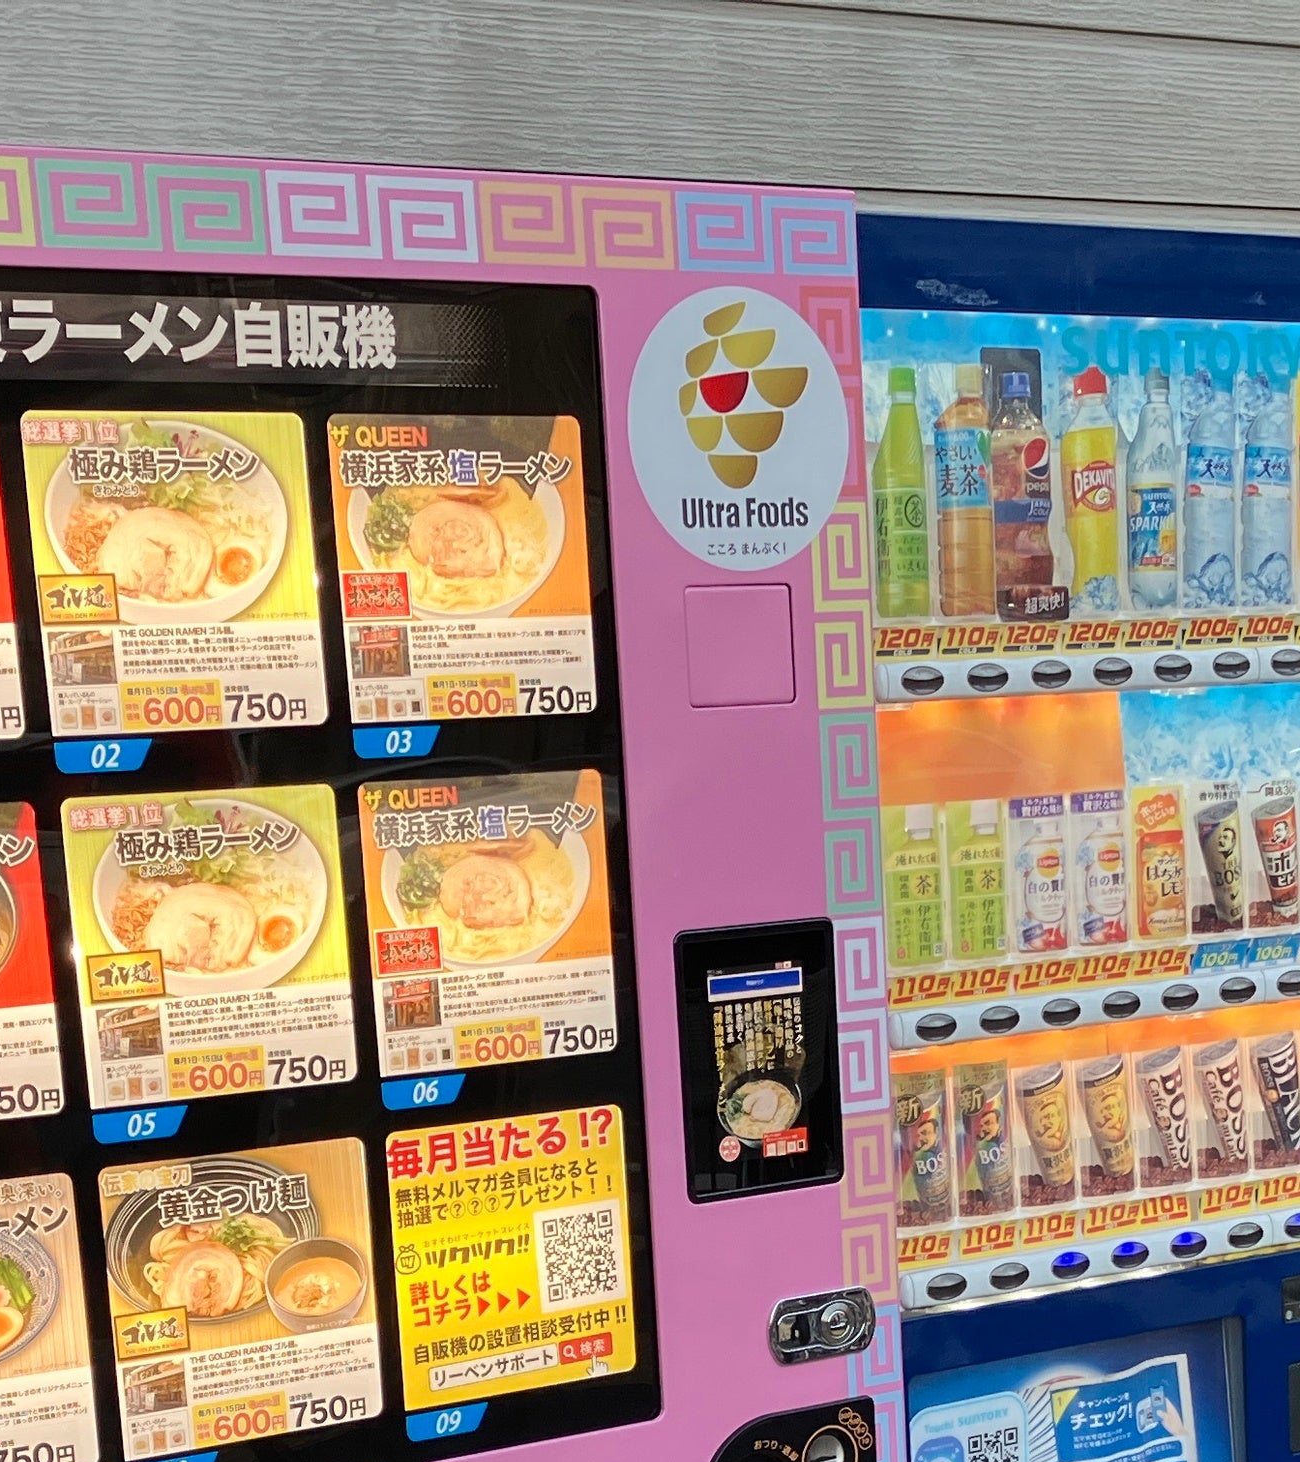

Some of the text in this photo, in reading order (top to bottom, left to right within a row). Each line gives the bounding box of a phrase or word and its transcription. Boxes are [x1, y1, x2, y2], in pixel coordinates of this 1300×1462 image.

[331, 425, 427, 448] ザ QUEEN
[69, 449, 258, 483] 極み鶏ラーメン
[936, 447, 976, 462] やさしい
[340, 451, 571, 484] 横浜家系塩ラーメン
[93, 484, 139, 497] きわみどり
[939, 464, 978, 497] 麦茶
[682, 498, 809, 528] Ultra Foods
[905, 496, 924, 525] 茶
[707, 543, 786, 555] こころ まんぷく!
[948, 628, 999, 646] 110円
[1004, 626, 1058, 644] 120円
[1066, 622, 1120, 642] 120円
[1129, 621, 1178, 640] 100円
[1189, 617, 1238, 637] 100円
[1246, 615, 1293, 635] 100円
[879, 628, 936, 648] 120円
[144, 697, 220, 724] 600円
[224, 694, 306, 723] 750円
[447, 690, 514, 715] 600円
[519, 687, 592, 714] 750円
[386, 730, 413, 754] 03
[91, 744, 121, 769] 02
[364, 786, 458, 811] ザ QUEEN
[373, 801, 597, 847] 横浜家系塩ラーメン
[116, 822, 300, 864] 極み鶏ラーメン
[916, 874, 932, 896] 茶
[980, 869, 996, 890] 茶
[918, 905, 932, 956] 伊右衛門
[982, 899, 996, 949] 伊右衛門
[1081, 954, 1130, 975] 110円
[1138, 948, 1186, 968] 110円
[1200, 950, 1238, 967] 100円
[1256, 945, 1292, 961] 100円
[896, 972, 950, 993] 110円
[958, 967, 1011, 989] 110円
[1024, 959, 1075, 982] 110円
[475, 1033, 540, 1062] 600円
[545, 1025, 614, 1053] 750円
[189, 1063, 262, 1092] 600円
[268, 1056, 346, 1085] 750円
[413, 1081, 438, 1103] 06
[1160, 1065, 1190, 1169] BOSS
[1217, 1056, 1245, 1160] BOSS
[127, 1112, 156, 1136] 05
[395, 1158, 598, 1209] 無料メルマガ会員になると
[1205, 1183, 1254, 1206] 110円
[158, 1174, 309, 1228] 黄金つけ麺
[1141, 1195, 1188, 1214] 110円
[1024, 1213, 1075, 1236] 110円
[1087, 1204, 1139, 1226] 110円
[900, 1234, 950, 1255] 110円
[965, 1224, 1015, 1246] 110円
[409, 1272, 491, 1306] 詳しくは
[413, 1299, 470, 1327] コチラ
[434, 1339, 605, 1387] リーベンサポート 検索
[290, 1395, 366, 1428] 750円
[436, 1411, 462, 1434] 09
[1071, 1404, 1133, 1431] チェック!
[213, 1410, 285, 1441] 600円
